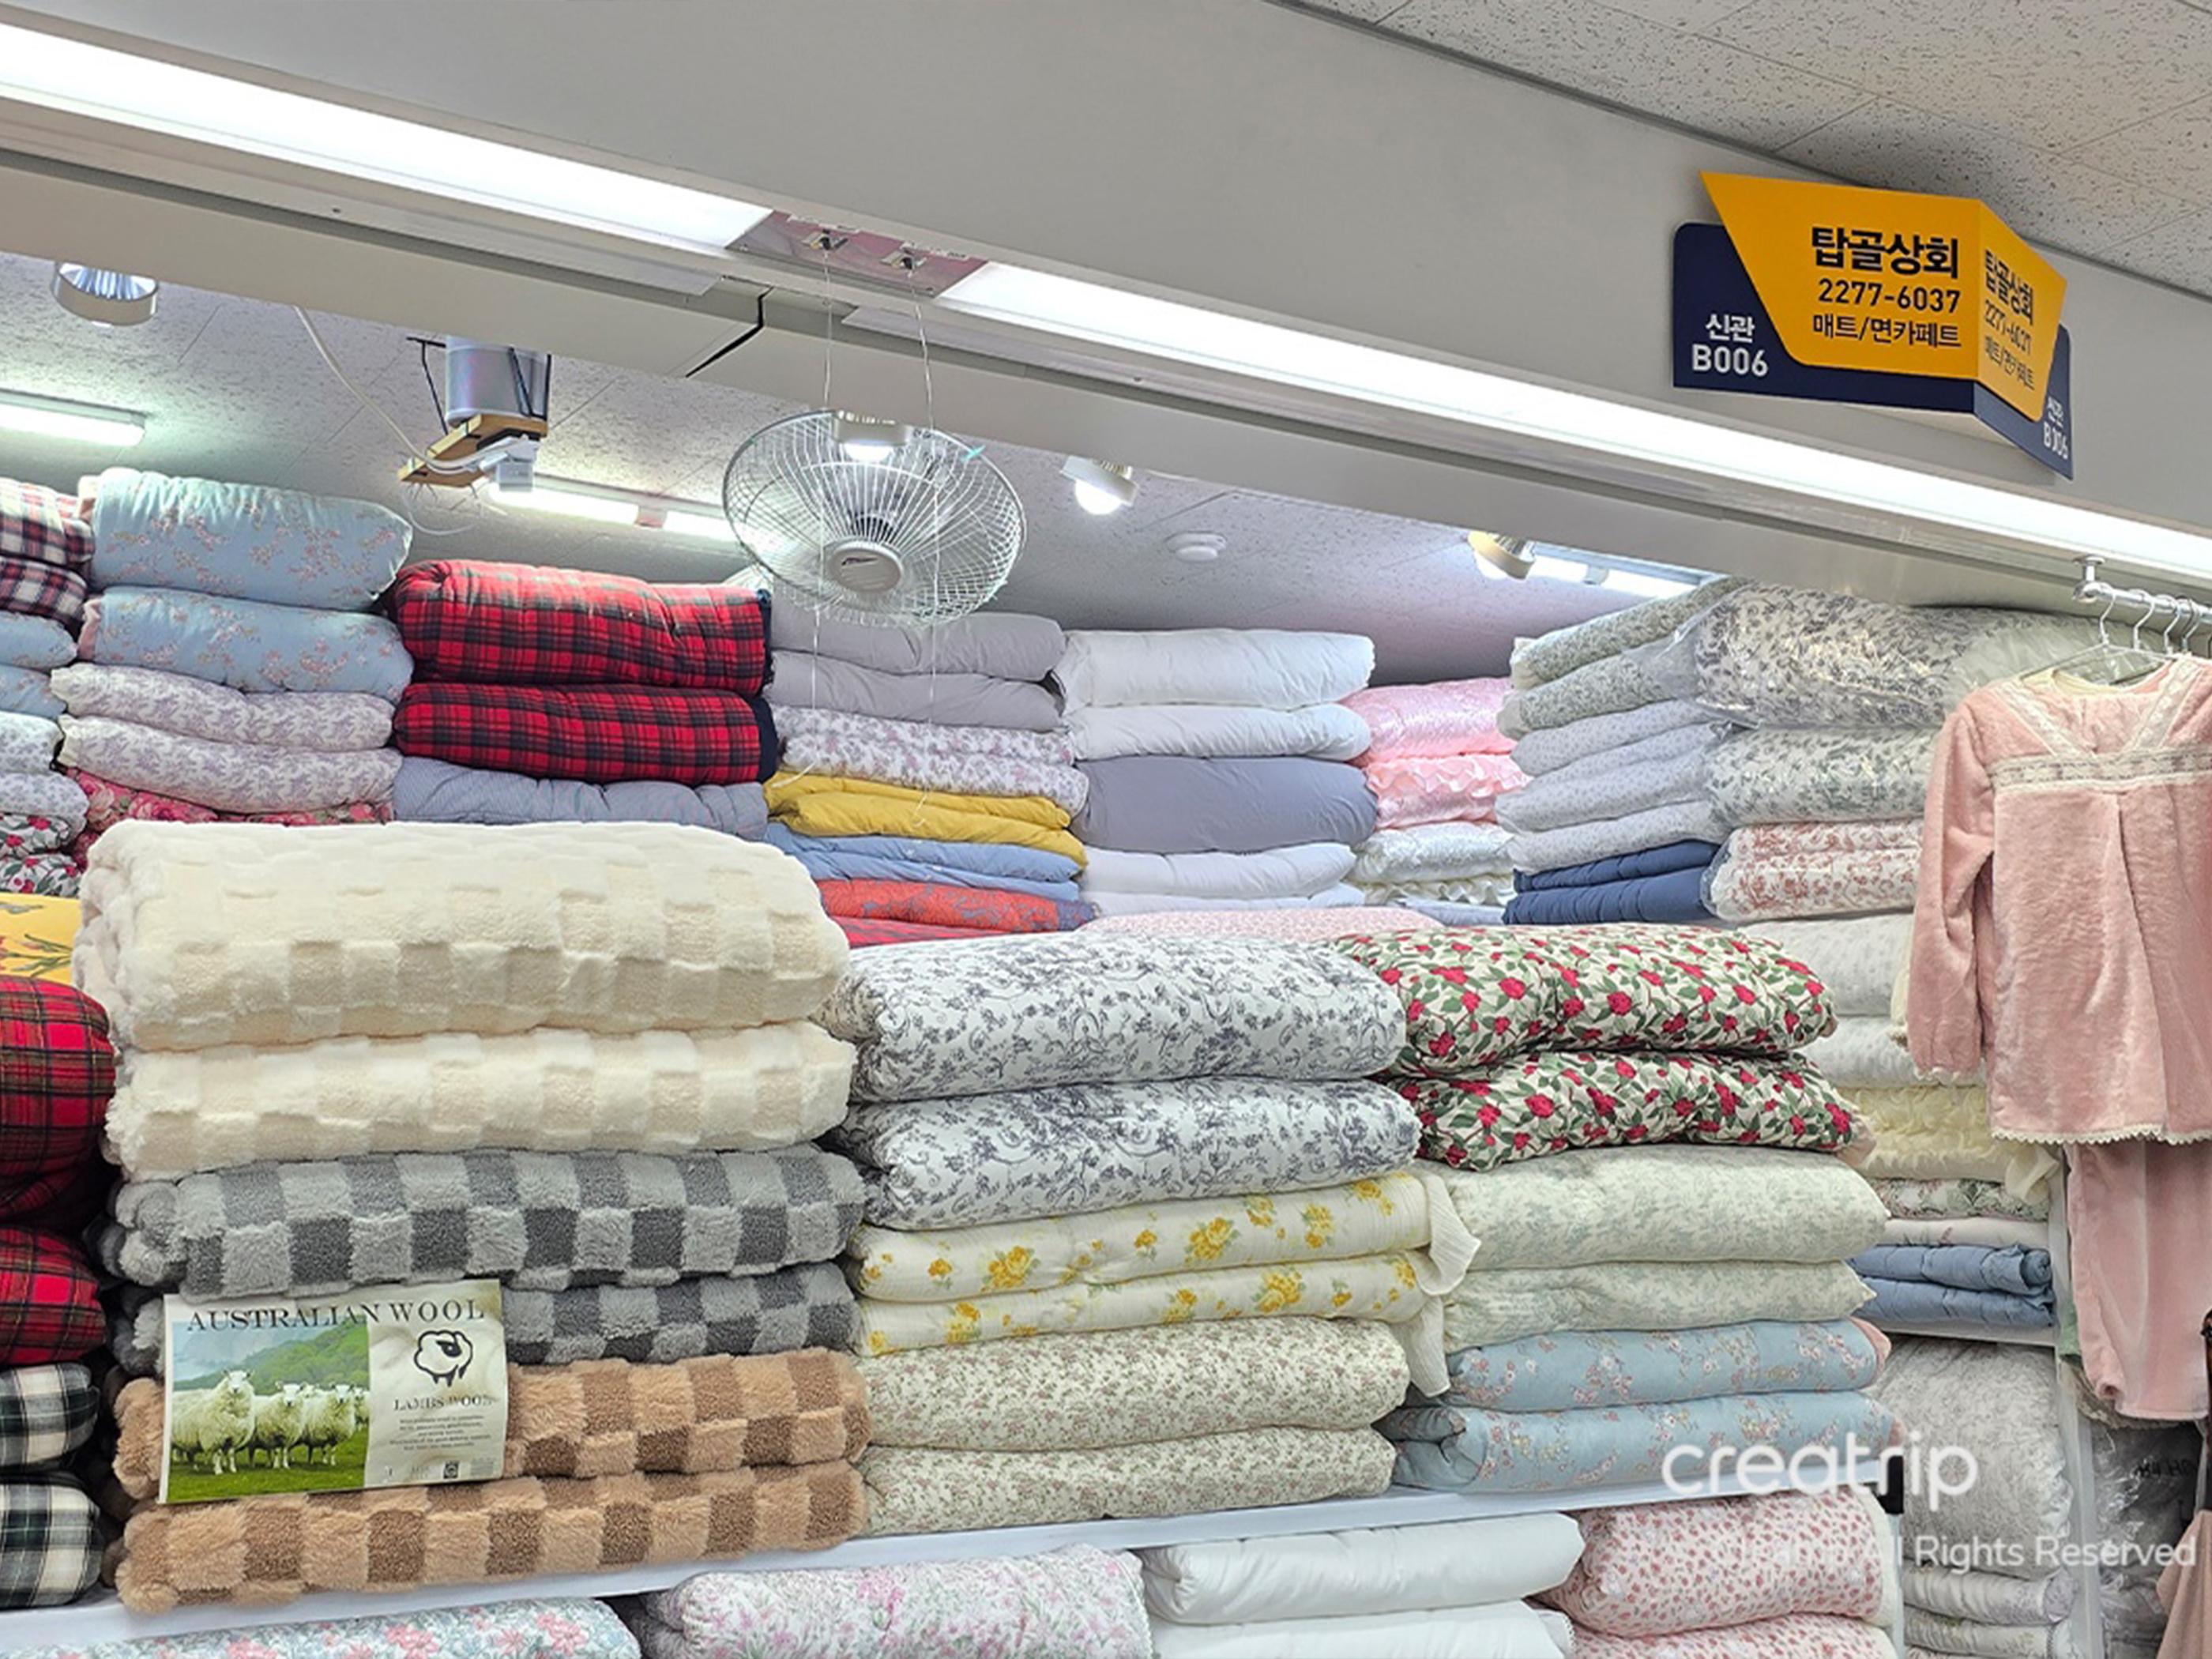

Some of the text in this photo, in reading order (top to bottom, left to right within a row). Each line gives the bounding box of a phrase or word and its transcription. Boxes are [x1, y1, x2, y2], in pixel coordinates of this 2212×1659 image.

[1811, 227, 1958, 280] 탑골상회
[1818, 277, 1961, 314] 2277-6037
[1706, 314, 1755, 344] 신관
[1813, 313, 1962, 348] 매트/면카페트
[1692, 344, 1769, 377] B006
[186, 1299, 486, 1332] AUSTRALIAN WOOL
